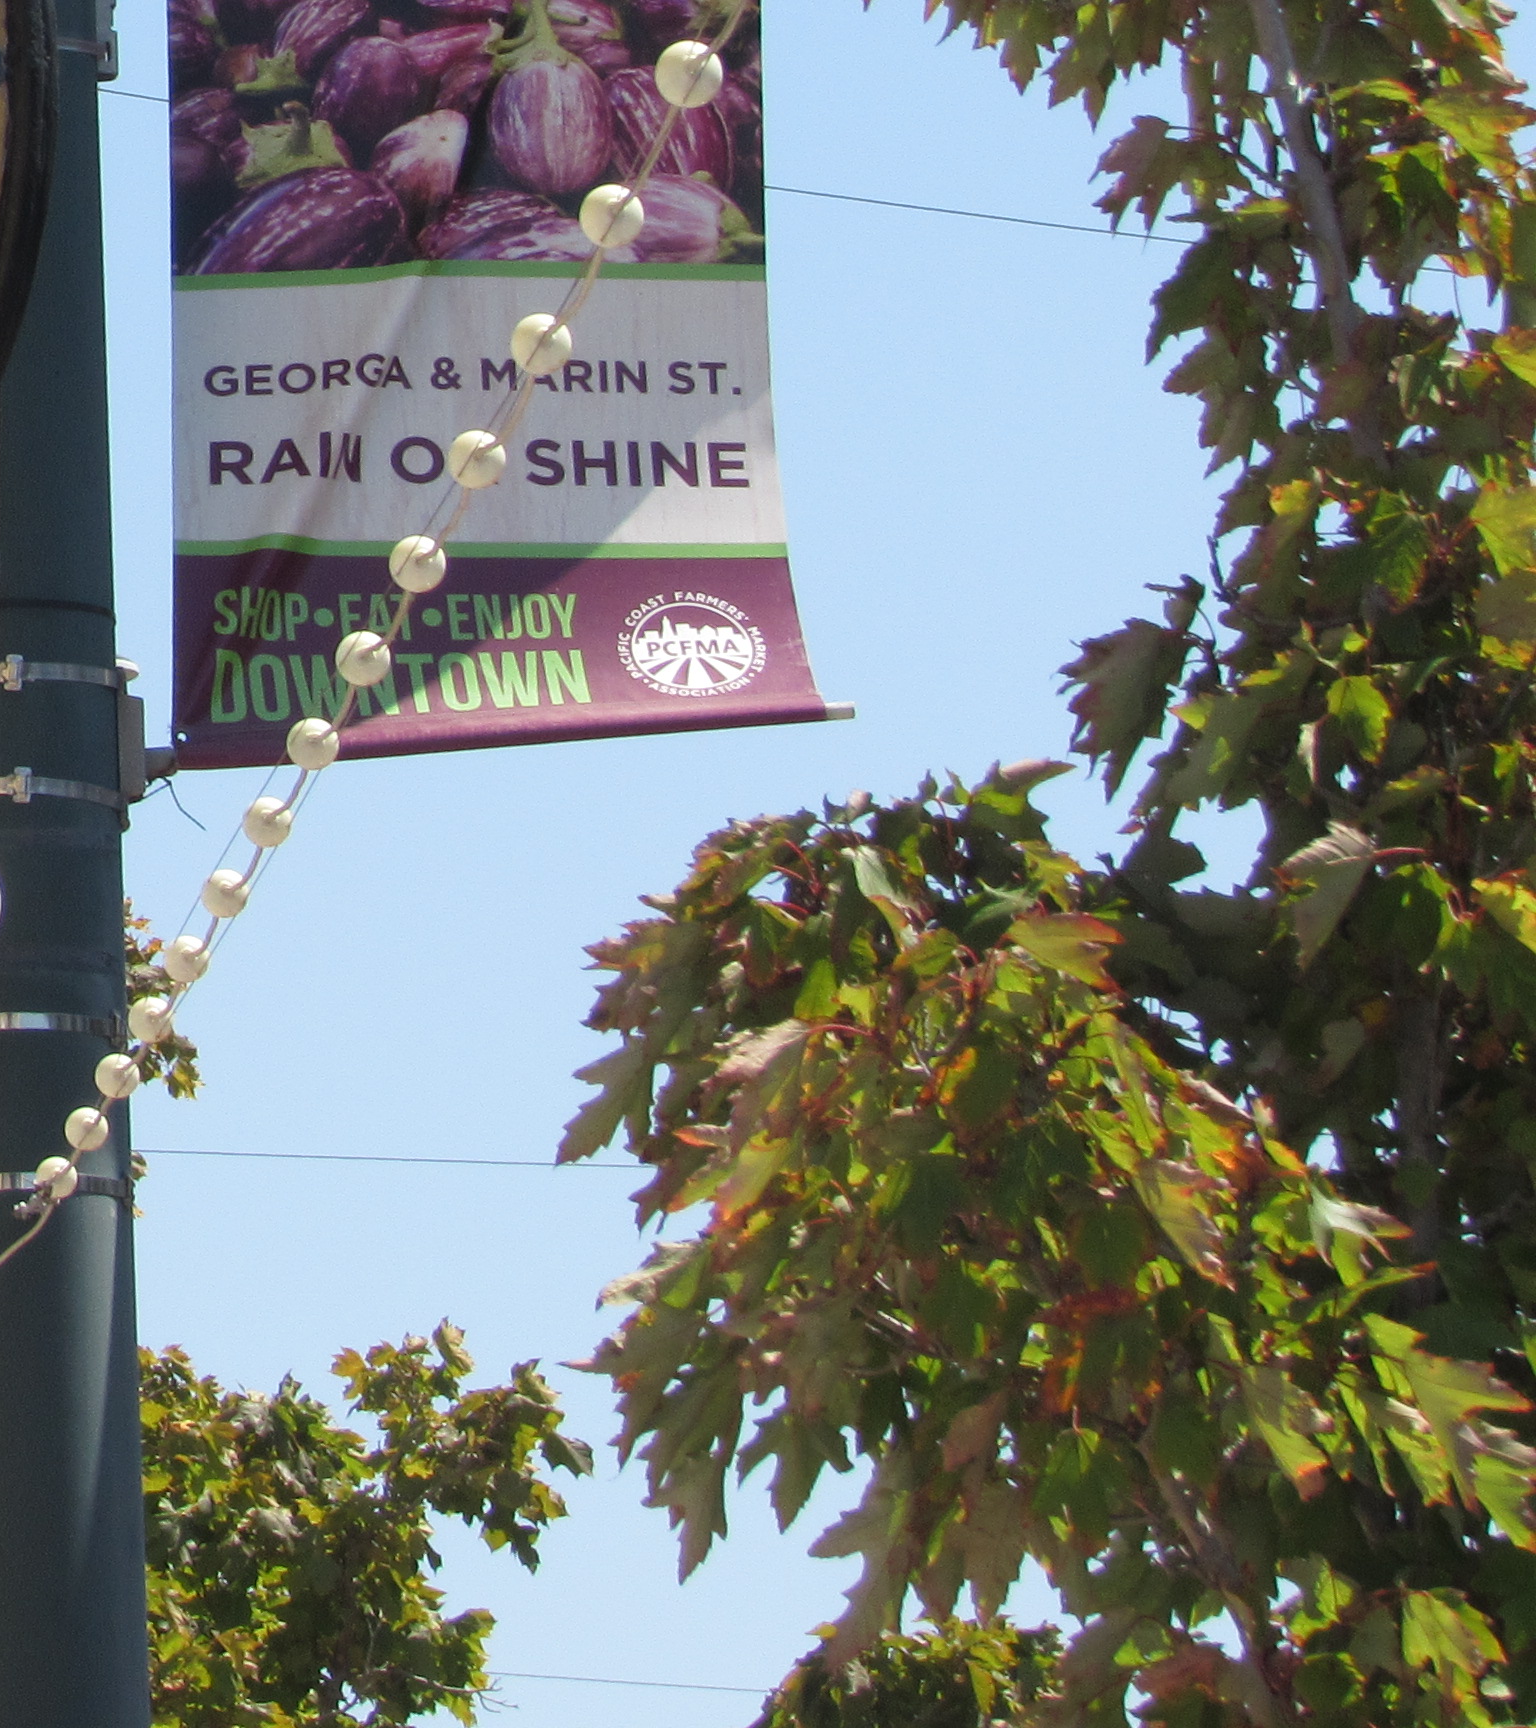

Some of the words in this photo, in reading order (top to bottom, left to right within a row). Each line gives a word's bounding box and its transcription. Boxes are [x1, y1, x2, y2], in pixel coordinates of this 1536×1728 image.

[430, 356, 462, 390] &
[668, 361, 742, 395] ST.
[526, 438, 750, 488] SHINE
[624, 594, 665, 627] COAST
[617, 631, 644, 680] PACIFIC
[646, 638, 741, 658] PCFMA
[747, 625, 767, 673] MARKET
[648, 675, 751, 697] ASSOCIATION
